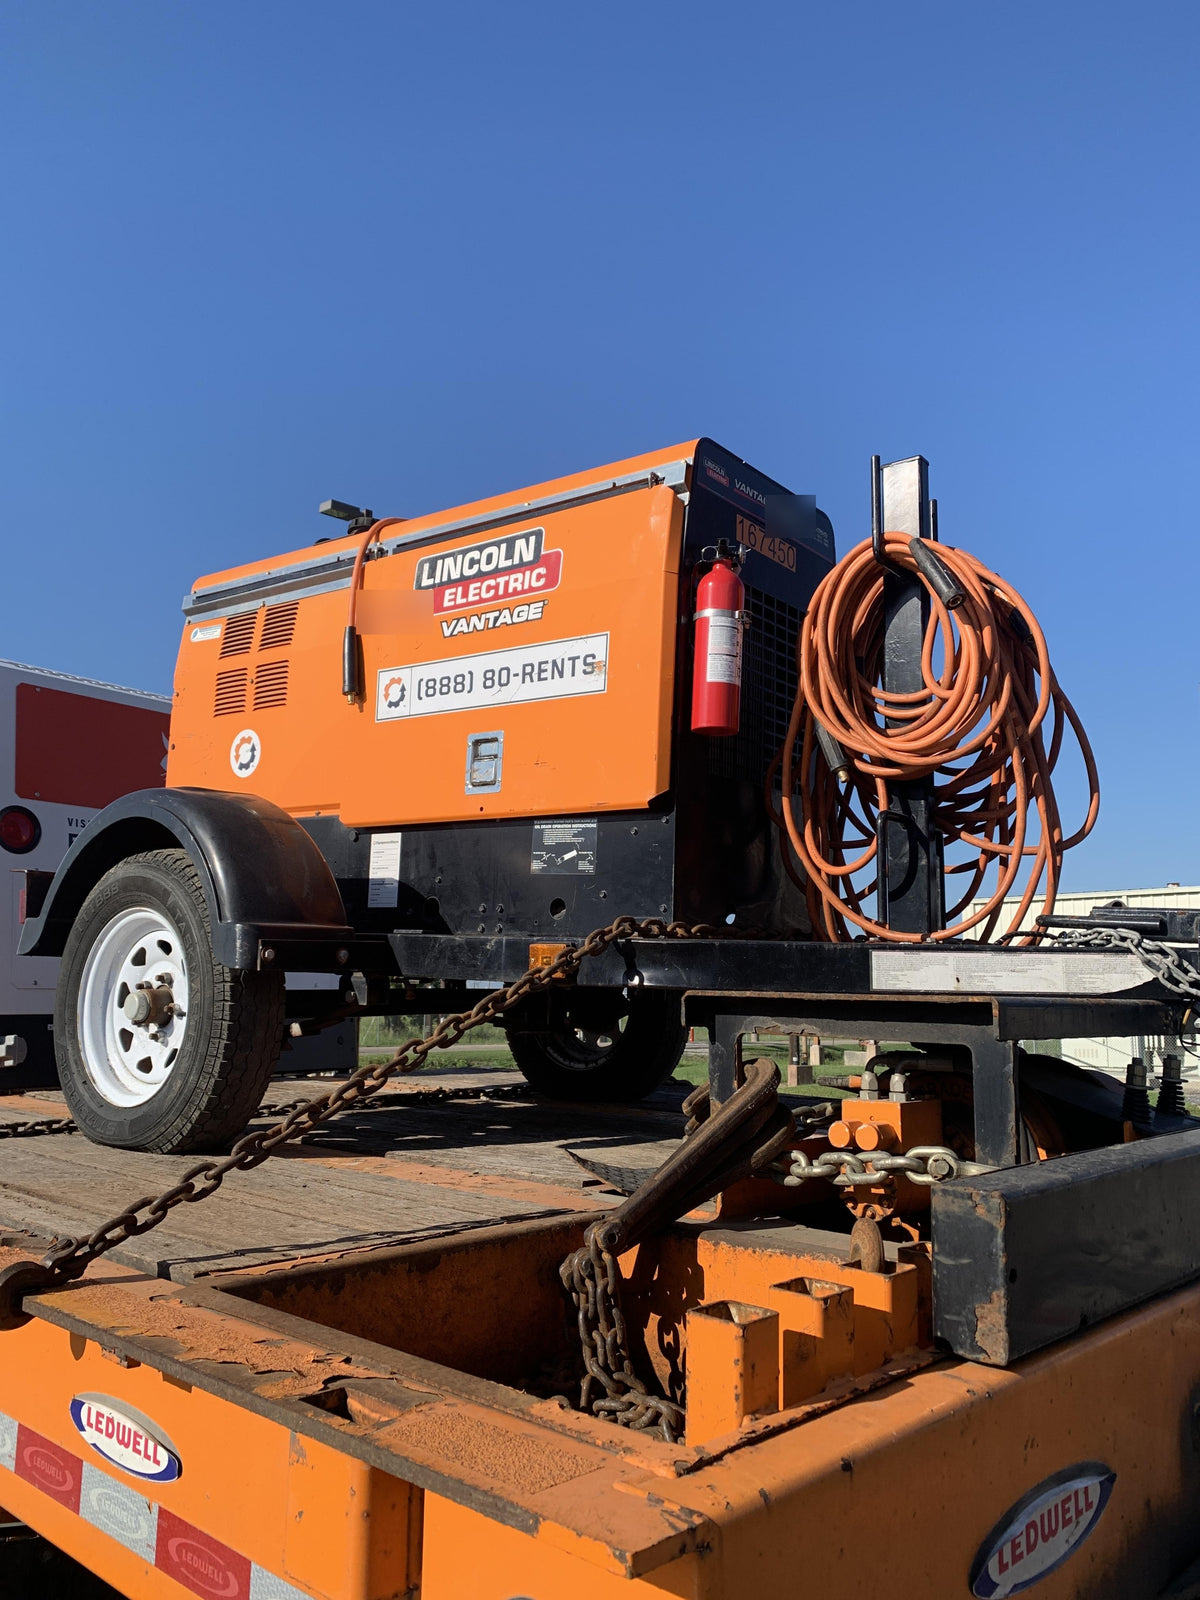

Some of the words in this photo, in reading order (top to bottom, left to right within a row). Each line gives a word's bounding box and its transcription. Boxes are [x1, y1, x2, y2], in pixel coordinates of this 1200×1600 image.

[420, 535, 536, 587] LINCOLN
[739, 518, 795, 569] 167450
[443, 566, 547, 608] ELECTRIC
[441, 600, 545, 638] VANTAGE
[417, 670, 474, 700] (888)
[482, 653, 597, 689] 80-RENTS
[67, 817, 89, 829] VIS
[86, 1406, 161, 1466] LEDWELL
[33, 1455, 63, 1481] LEDWELL
[997, 1486, 1094, 1576] LEDWELL
[182, 1549, 224, 1585] LEDWELL
